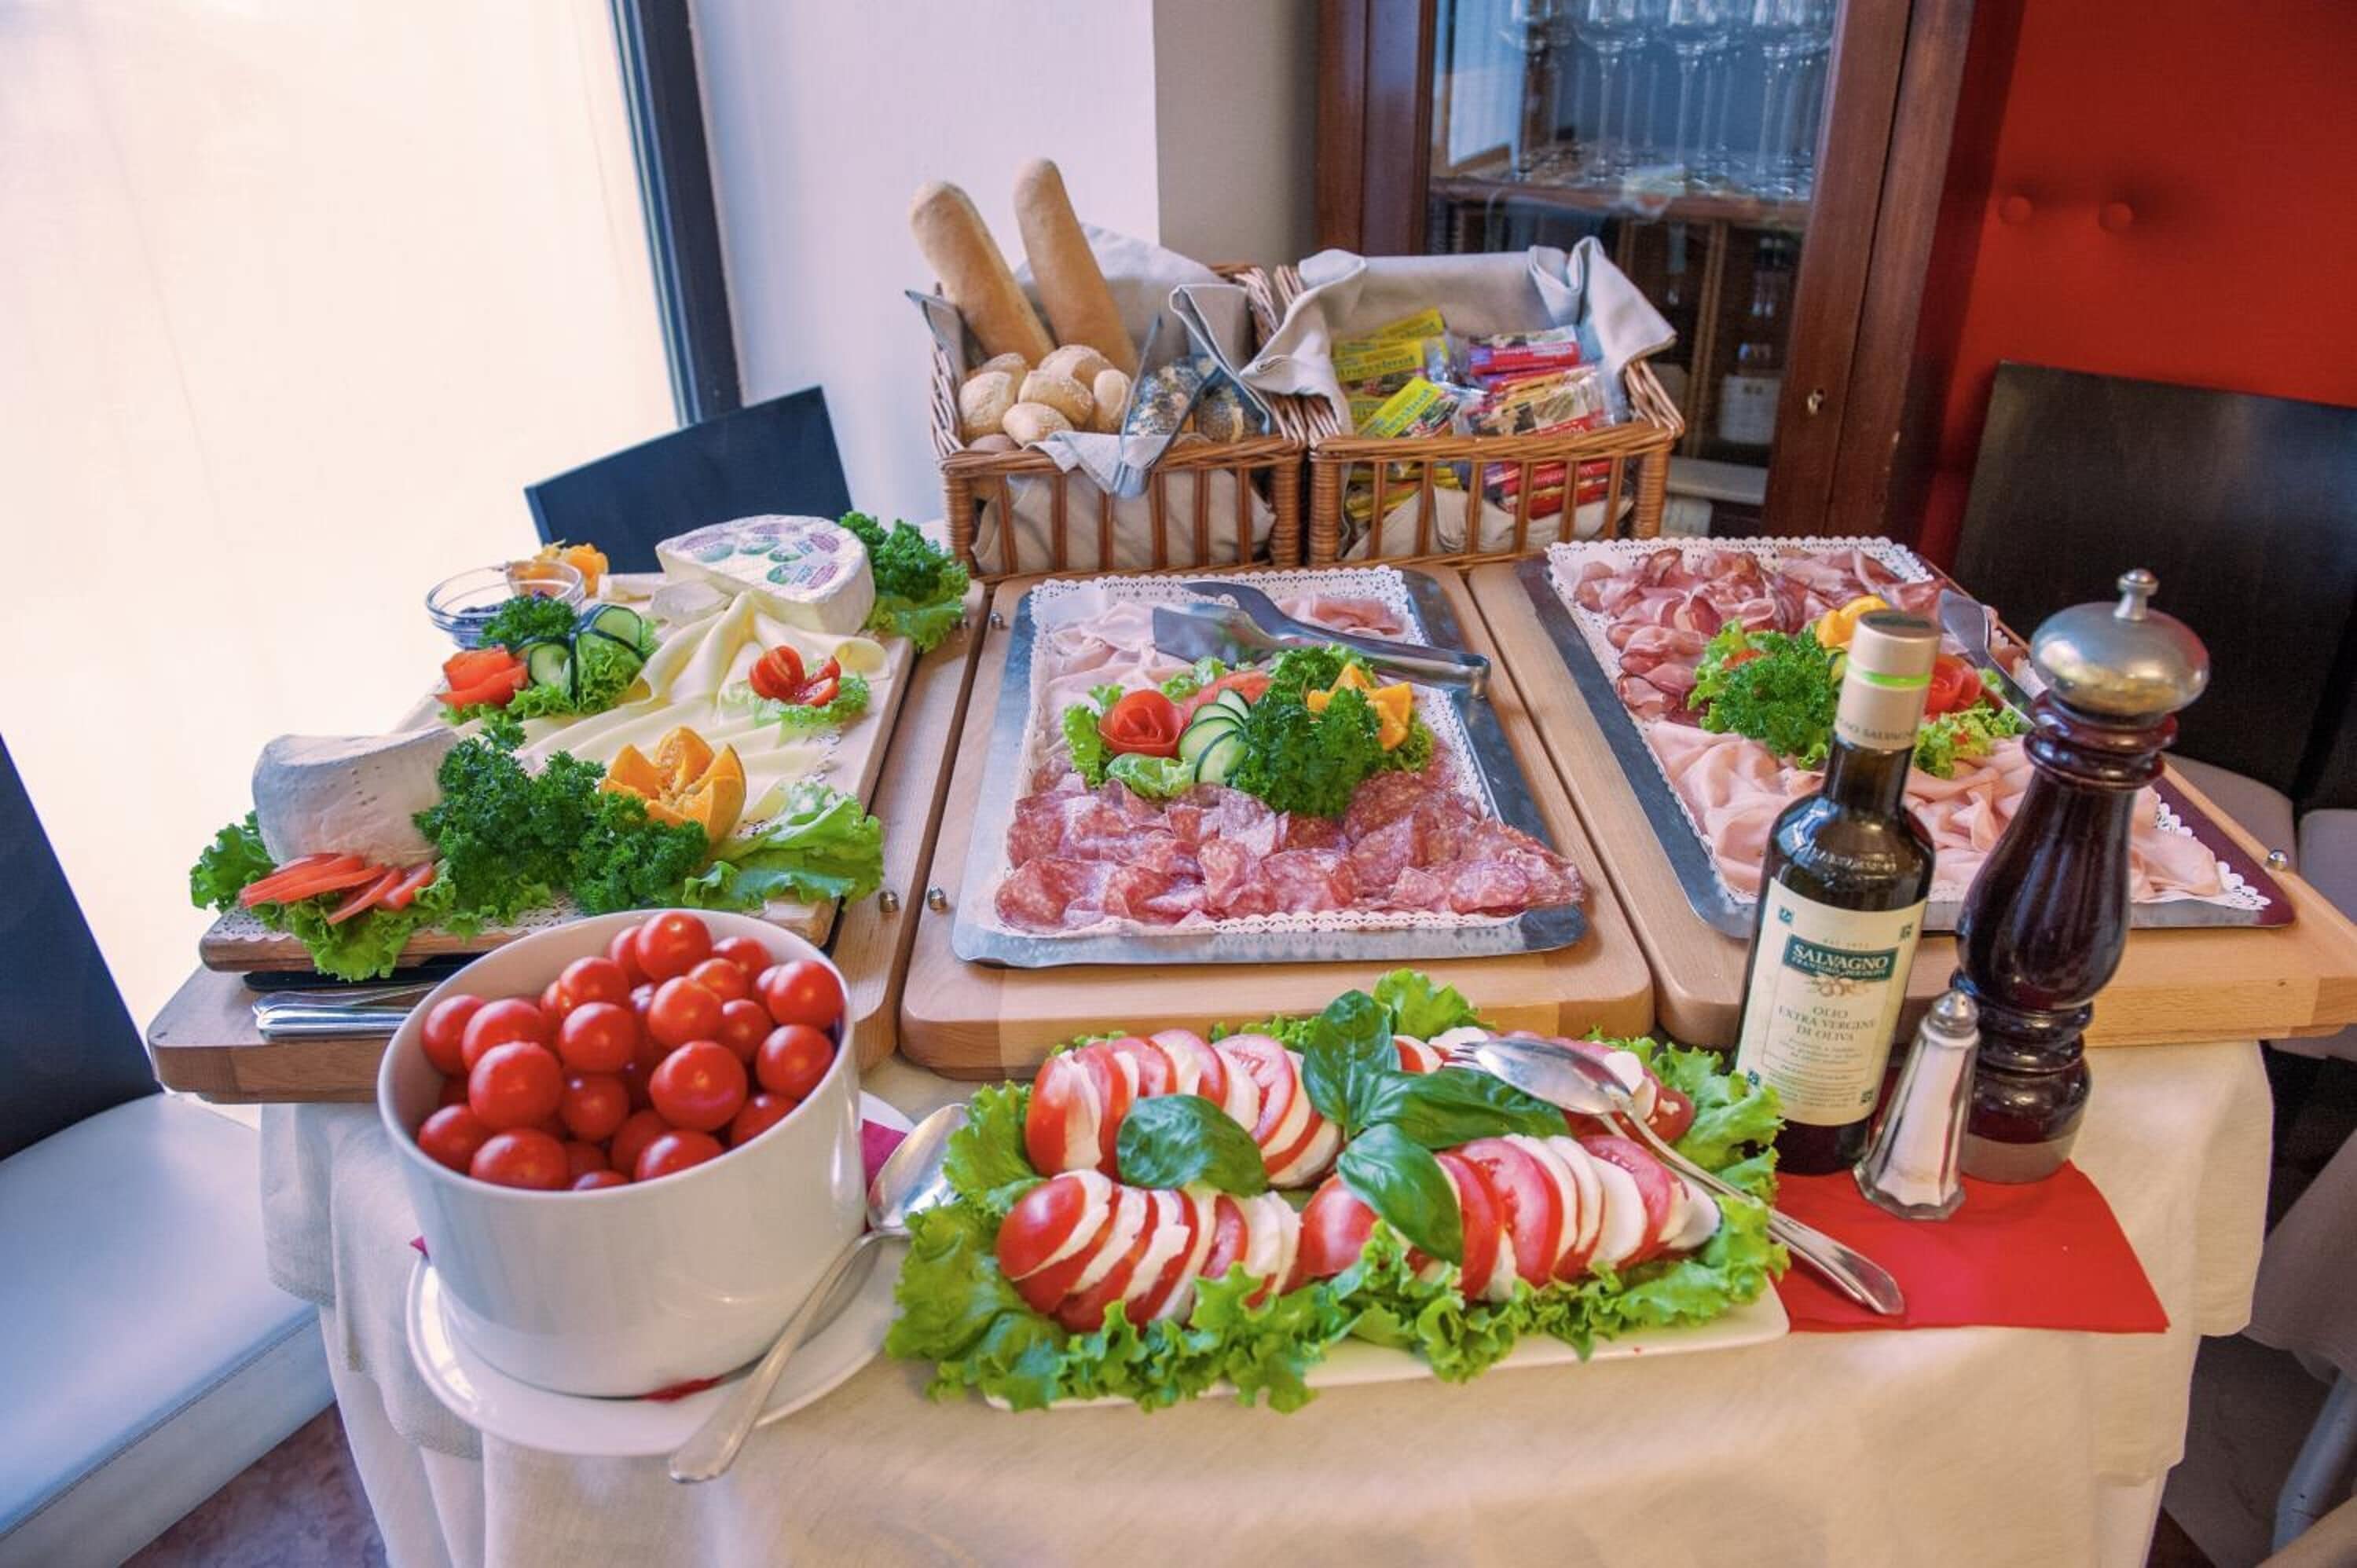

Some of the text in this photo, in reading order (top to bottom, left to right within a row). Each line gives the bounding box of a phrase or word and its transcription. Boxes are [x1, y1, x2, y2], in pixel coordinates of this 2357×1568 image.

[1793, 943, 1889, 969] SALVAGNO
[1778, 1005, 1875, 1031] EXTRA VERGINE
[1813, 1006, 1849, 1019] OLIO
[1797, 1024, 1854, 1042] DI OLIVA
